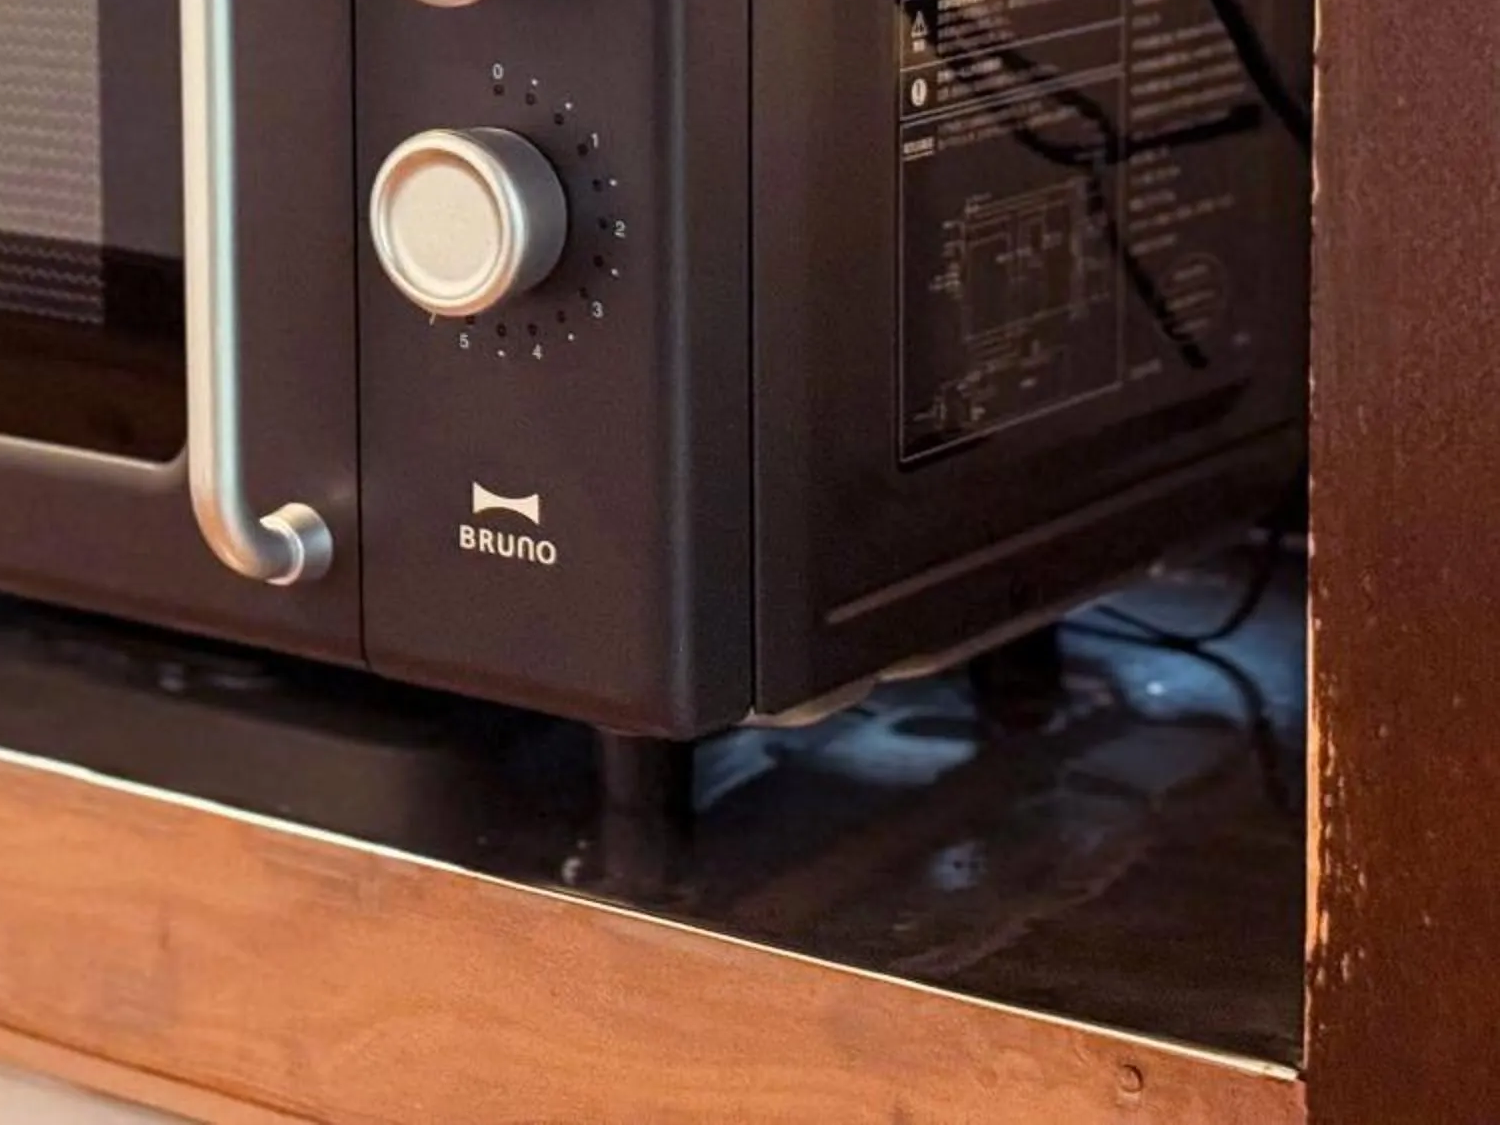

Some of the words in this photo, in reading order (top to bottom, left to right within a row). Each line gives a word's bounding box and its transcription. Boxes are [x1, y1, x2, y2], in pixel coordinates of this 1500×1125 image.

[492, 63, 504, 80] 0
[591, 132, 599, 148] 1
[614, 220, 626, 238] 2
[592, 301, 604, 318] 3
[459, 333, 470, 349] 5
[532, 344, 542, 360] 4
[459, 524, 557, 565] BRUNO
